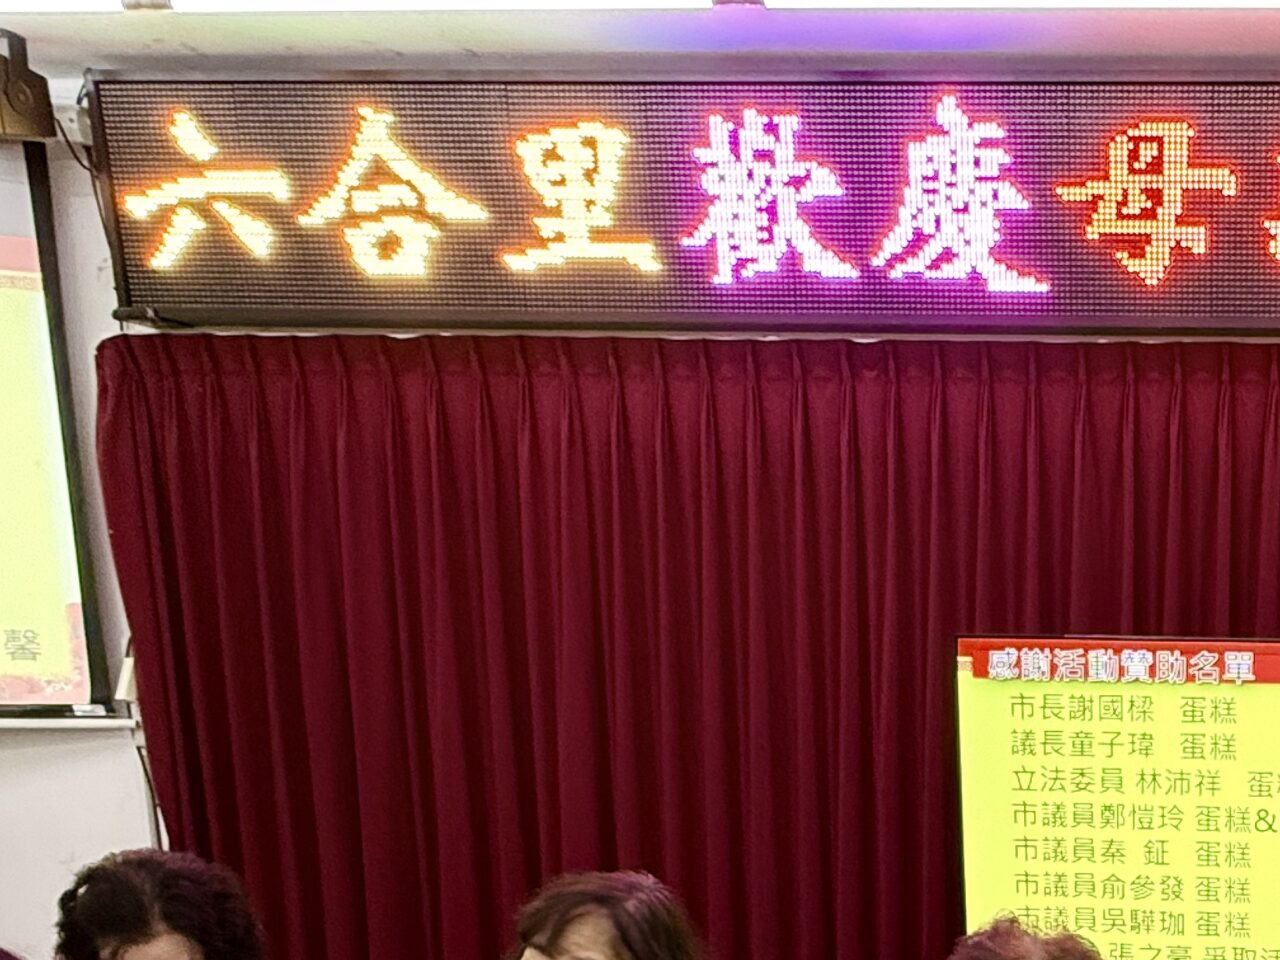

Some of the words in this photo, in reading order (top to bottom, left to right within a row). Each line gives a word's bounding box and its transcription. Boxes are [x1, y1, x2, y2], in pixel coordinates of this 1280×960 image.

[1179, 696, 1238, 725] 蛋糕
[1010, 729, 1155, 760] 議長童子瑋
[1179, 733, 1238, 761] 蛋糕
[1011, 765, 1125, 795] 立法委員
[1135, 768, 1222, 797] 林沛祥
[1011, 801, 1185, 832] 市議員鄭愷玲
[1195, 841, 1252, 869] 蛋糕
[1195, 876, 1252, 904] 蛋糕
[1195, 911, 1252, 939] 蛋糕
